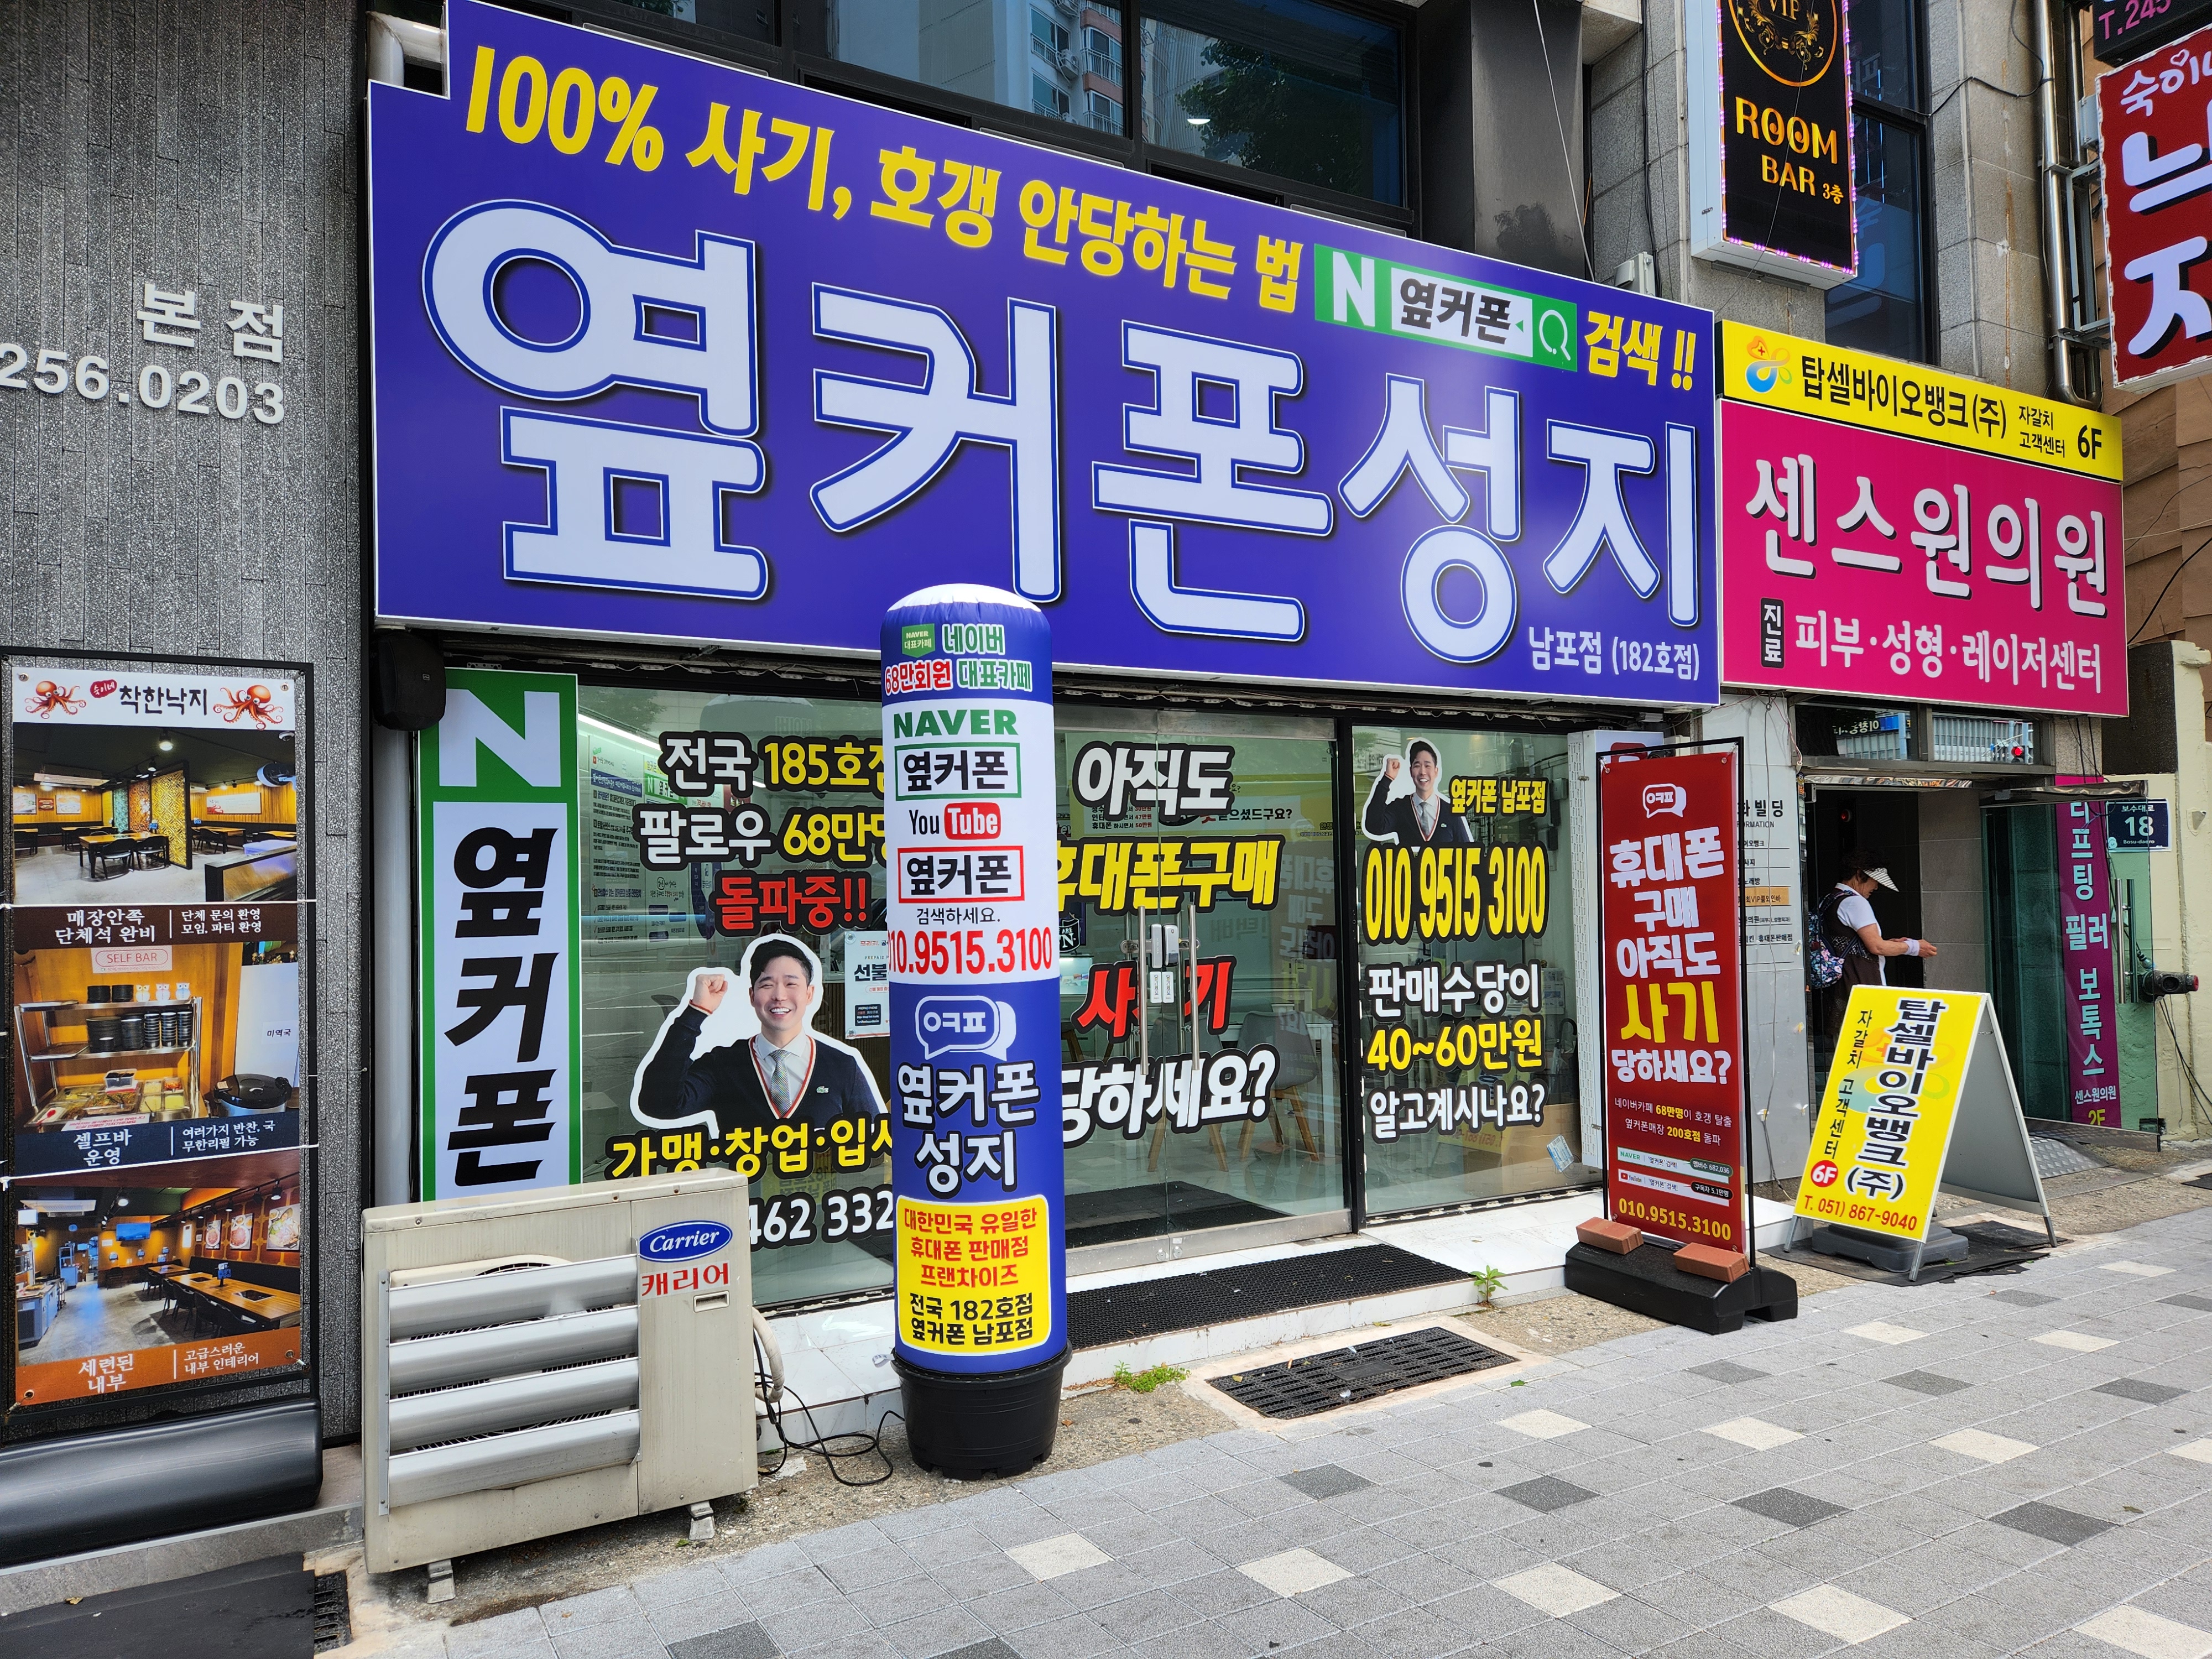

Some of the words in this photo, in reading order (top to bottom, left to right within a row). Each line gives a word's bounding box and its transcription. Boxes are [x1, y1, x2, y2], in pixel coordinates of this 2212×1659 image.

[1735, 97, 1838, 164] ROOM
[466, 45, 664, 172] 100%
[686, 102, 852, 220] 사기,
[870, 145, 1002, 248] 호갱
[1019, 180, 1238, 300] 안당하는
[1255, 234, 1303, 313] 법
[1761, 154, 1815, 196] BAR
[1823, 183, 1844, 205] 3층
[1333, 251, 1375, 327] N
[1400, 278, 1511, 345] 옆커폰
[1585, 311, 1663, 386] 검색
[421, 197, 1699, 664] 옆커폰성지
[2018, 405, 2054, 430] 자갈치
[2018, 431, 2066, 458] 고객센터
[2077, 424, 2103, 460] 6F
[1746, 453, 2107, 618] 센스원의원
[904, 640, 932, 650] 대표카페
[906, 631, 929, 639] NAVER
[942, 624, 1005, 655] 네이버
[1764, 603, 1782, 664] 진료
[1529, 626, 1602, 675] 남포점
[1612, 637, 1700, 681] (182호점)
[93, 681, 115, 696] 숙이네
[885, 659, 953, 696] 68만회원
[957, 659, 1032, 692] 대표카페
[119, 685, 207, 716] 착한낙지
[439, 689, 561, 787] N
[894, 709, 1019, 739] NAVER
[666, 738, 752, 791] 전국
[904, 750, 1009, 792] 옆커폰
[1078, 747, 1230, 817] 아직도
[1451, 778, 1497, 814] 옆커폰
[1502, 779, 1546, 814] 남포점
[2121, 805, 2155, 813] 보수대로
[640, 811, 771, 864] 팔로우
[2124, 816, 2154, 836] 18
[1610, 826, 1725, 889] 휴대폰
[907, 855, 1012, 895] 옆커폰
[716, 875, 866, 930] 돌파중!!
[1366, 847, 1412, 941] 010
[1420, 847, 1481, 937] 9515
[1488, 846, 1546, 936] 3100
[1634, 886, 1699, 932] 구매
[67, 909, 145, 927] 매장안쪽
[181, 910, 206, 922] 단체
[210, 909, 234, 921] 문의
[237, 908, 260, 921] 환영
[211, 921, 234, 933] 파티
[238, 920, 262, 933] 환영
[916, 907, 1000, 925] 검색하세요.
[55, 927, 112, 945] 단체석
[119, 925, 155, 943] 완비
[2065, 913, 2109, 951] 필러
[107, 954, 132, 964] SELF
[135, 952, 157, 962] BAR
[1616, 932, 1721, 979] 아직도
[854, 963, 888, 982] 선불
[1369, 964, 1539, 1018] 판매수당이
[444, 827, 560, 1188] 옆커폰
[1620, 980, 1720, 1044] 사기
[2079, 968, 2105, 1076] 보톡스
[267, 1029, 291, 1037] 미역국
[1367, 1019, 1542, 1071] 40~60만원
[1847, 1009, 1872, 1069] 자갈치
[1611, 1048, 1731, 1085] 당하세요?
[898, 1062, 1039, 1125] 옆커폰
[2074, 1086, 2117, 1105] 센스원의원
[1370, 1084, 1545, 1139] 알고계시나요?
[1614, 1097, 1653, 1114] 네이버카페
[1656, 1104, 1692, 1121] 68만명이
[1694, 1111, 1712, 1124] 호갱
[1715, 1114, 1733, 1128] 탈출
[1823, 1078, 1854, 1160] 고객센터
[2088, 1109, 2105, 1126] 2F
[74, 1129, 133, 1150] 셀프바
[182, 1124, 229, 1140] 여러가지
[263, 1120, 276, 1132] 국
[182, 1138, 231, 1153] 무한리필
[234, 1136, 259, 1147] 가능
[1625, 1118, 1665, 1135] 옆커폰매장
[1667, 1126, 1701, 1142] 200호점
[1703, 1133, 1721, 1146] 돌파
[83, 1147, 121, 1166] 운영
[916, 1131, 1015, 1193] 성지
[1620, 1151, 1641, 1160] NAVER
[1666, 1160, 1678, 1169] 검색!
[1693, 1160, 1708, 1170] 멤버수
[1709, 1165, 1730, 1174] 682,036
[1629, 1174, 1642, 1183] YouTube
[1666, 1182, 1678, 1192] 검색!
[1812, 1165, 1838, 1184] 6F
[1694, 1183, 1710, 1193] 구독자
[1711, 1187, 1729, 1198] 5.1만명
[904, 1207, 973, 1235] 대한민국
[980, 1207, 1037, 1234] 유일한
[1619, 1198, 1731, 1241] 010.9515.3100
[1818, 1198, 1845, 1218] 051)
[1849, 1203, 1917, 1231] 867-9040
[650, 1229, 719, 1253] Carrier
[911, 1236, 962, 1261] 휴대폰
[968, 1235, 1029, 1261] 판매점
[641, 1262, 729, 1297] 캐리어
[921, 1264, 1019, 1288] 프랜차이즈
[910, 1292, 943, 1320] 전국
[950, 1292, 1033, 1321] 182호점
[911, 1317, 966, 1346] 옆커폰
[973, 1317, 1033, 1346] 남포점
[79, 1353, 134, 1377] 세련된
[184, 1342, 246, 1362] 고급스러운
[185, 1361, 210, 1375] 내부
[213, 1353, 259, 1370] 인테리어
[88, 1375, 127, 1394] 내부
